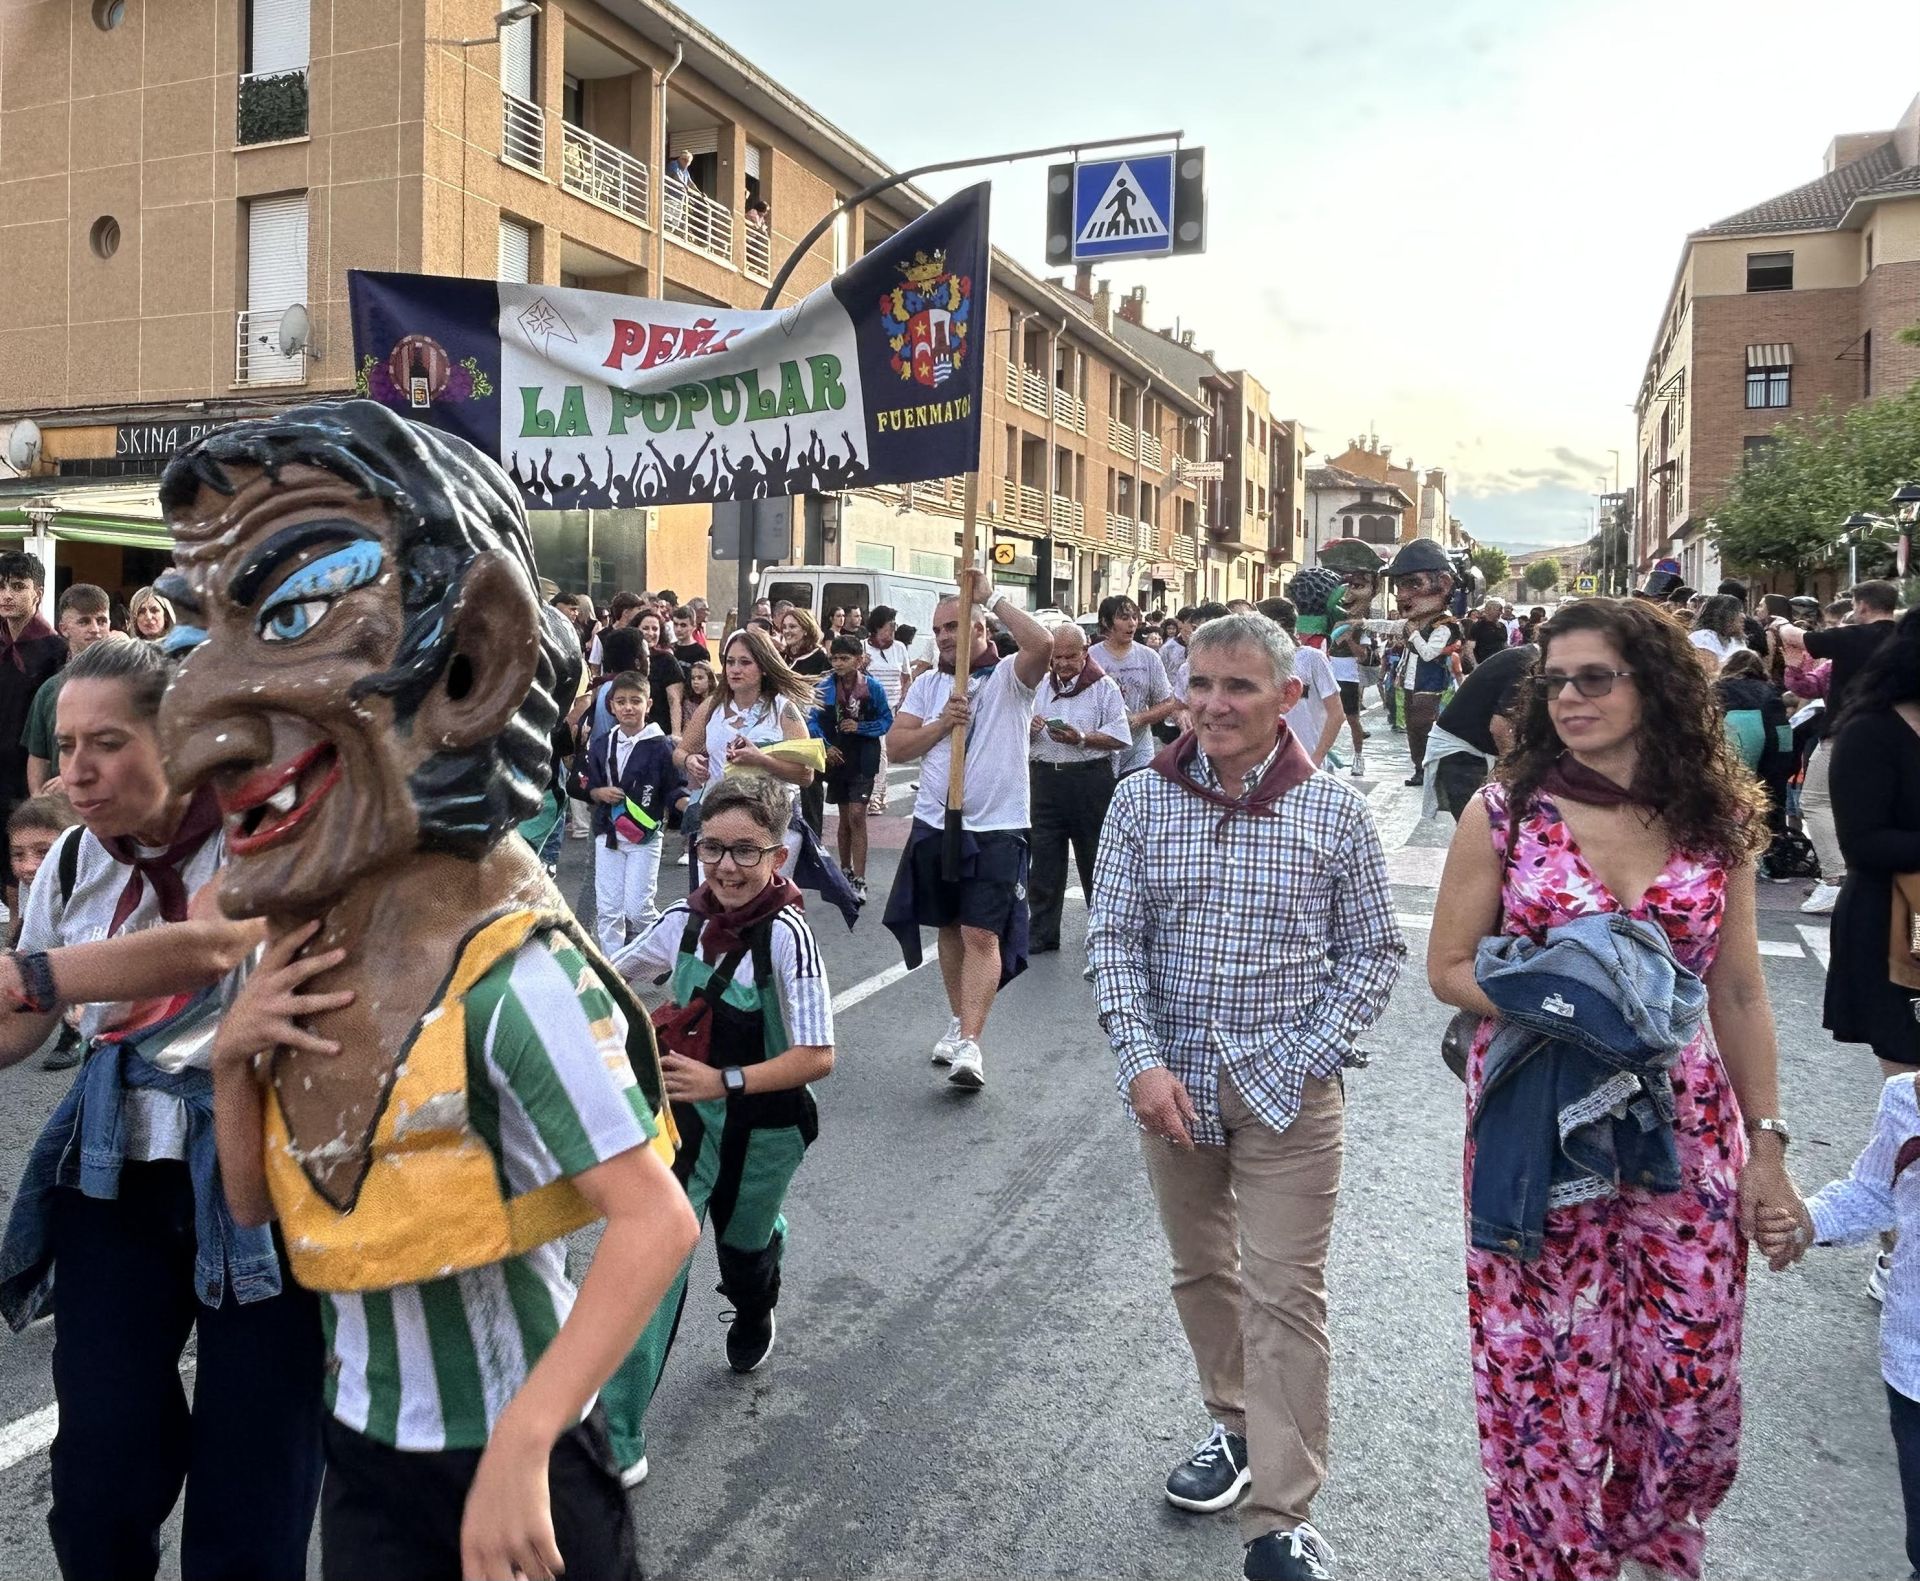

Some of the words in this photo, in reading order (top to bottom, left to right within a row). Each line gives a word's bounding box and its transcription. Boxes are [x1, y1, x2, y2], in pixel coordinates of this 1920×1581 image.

[519, 386, 593, 437] LA
[607, 354, 847, 435] POPULAR
[116, 427, 177, 454] SKINA
